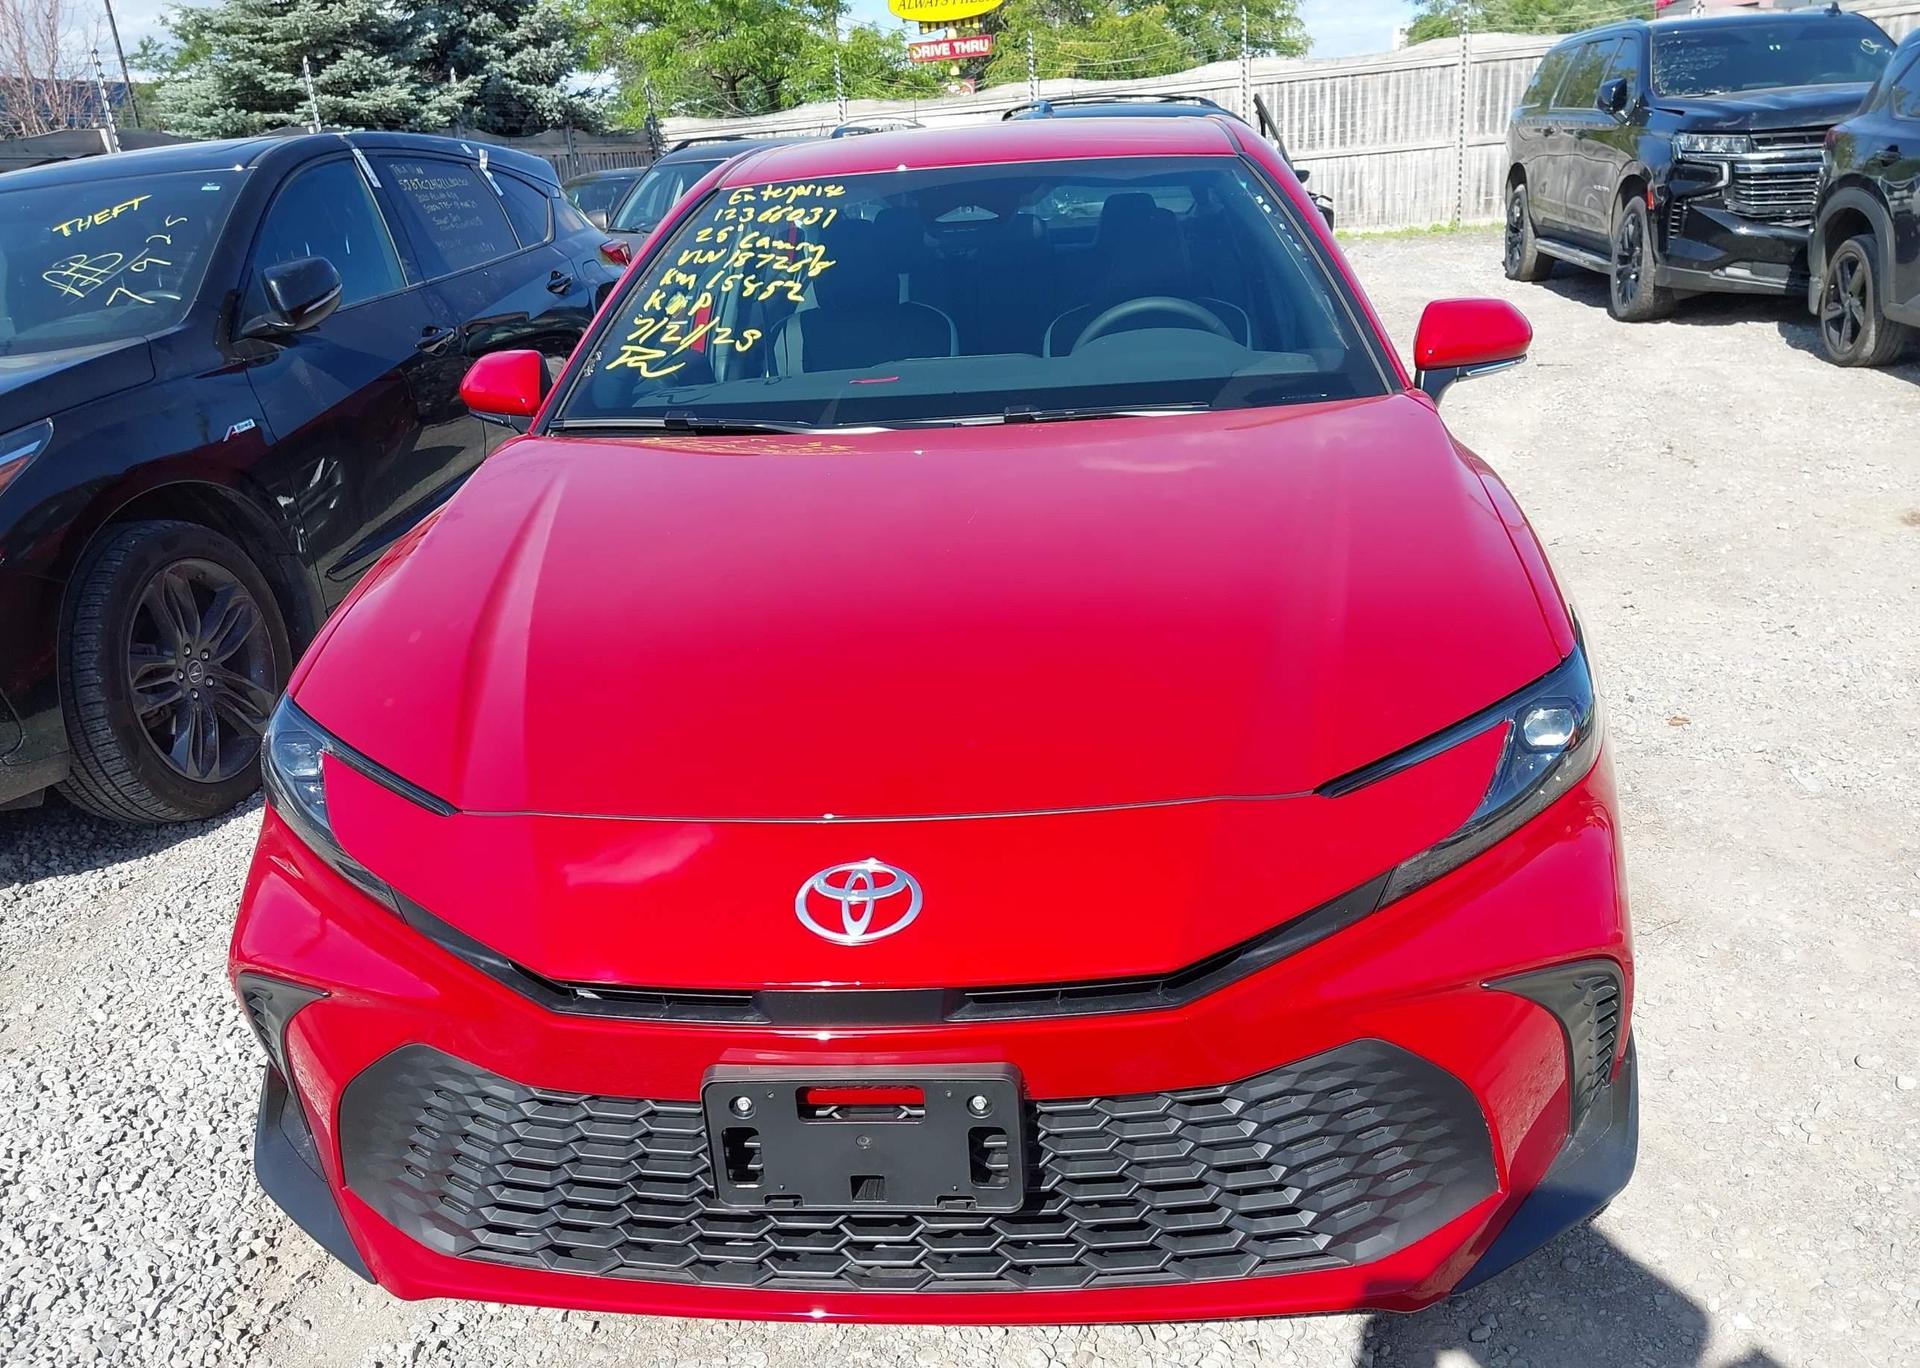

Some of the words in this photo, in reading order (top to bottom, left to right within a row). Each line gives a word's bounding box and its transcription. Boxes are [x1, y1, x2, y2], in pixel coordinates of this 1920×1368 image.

[911, 43, 950, 59] DRIVE
[953, 39, 989, 55] THRU
[52, 194, 152, 237] THEFT
[739, 231, 826, 271] Camry
